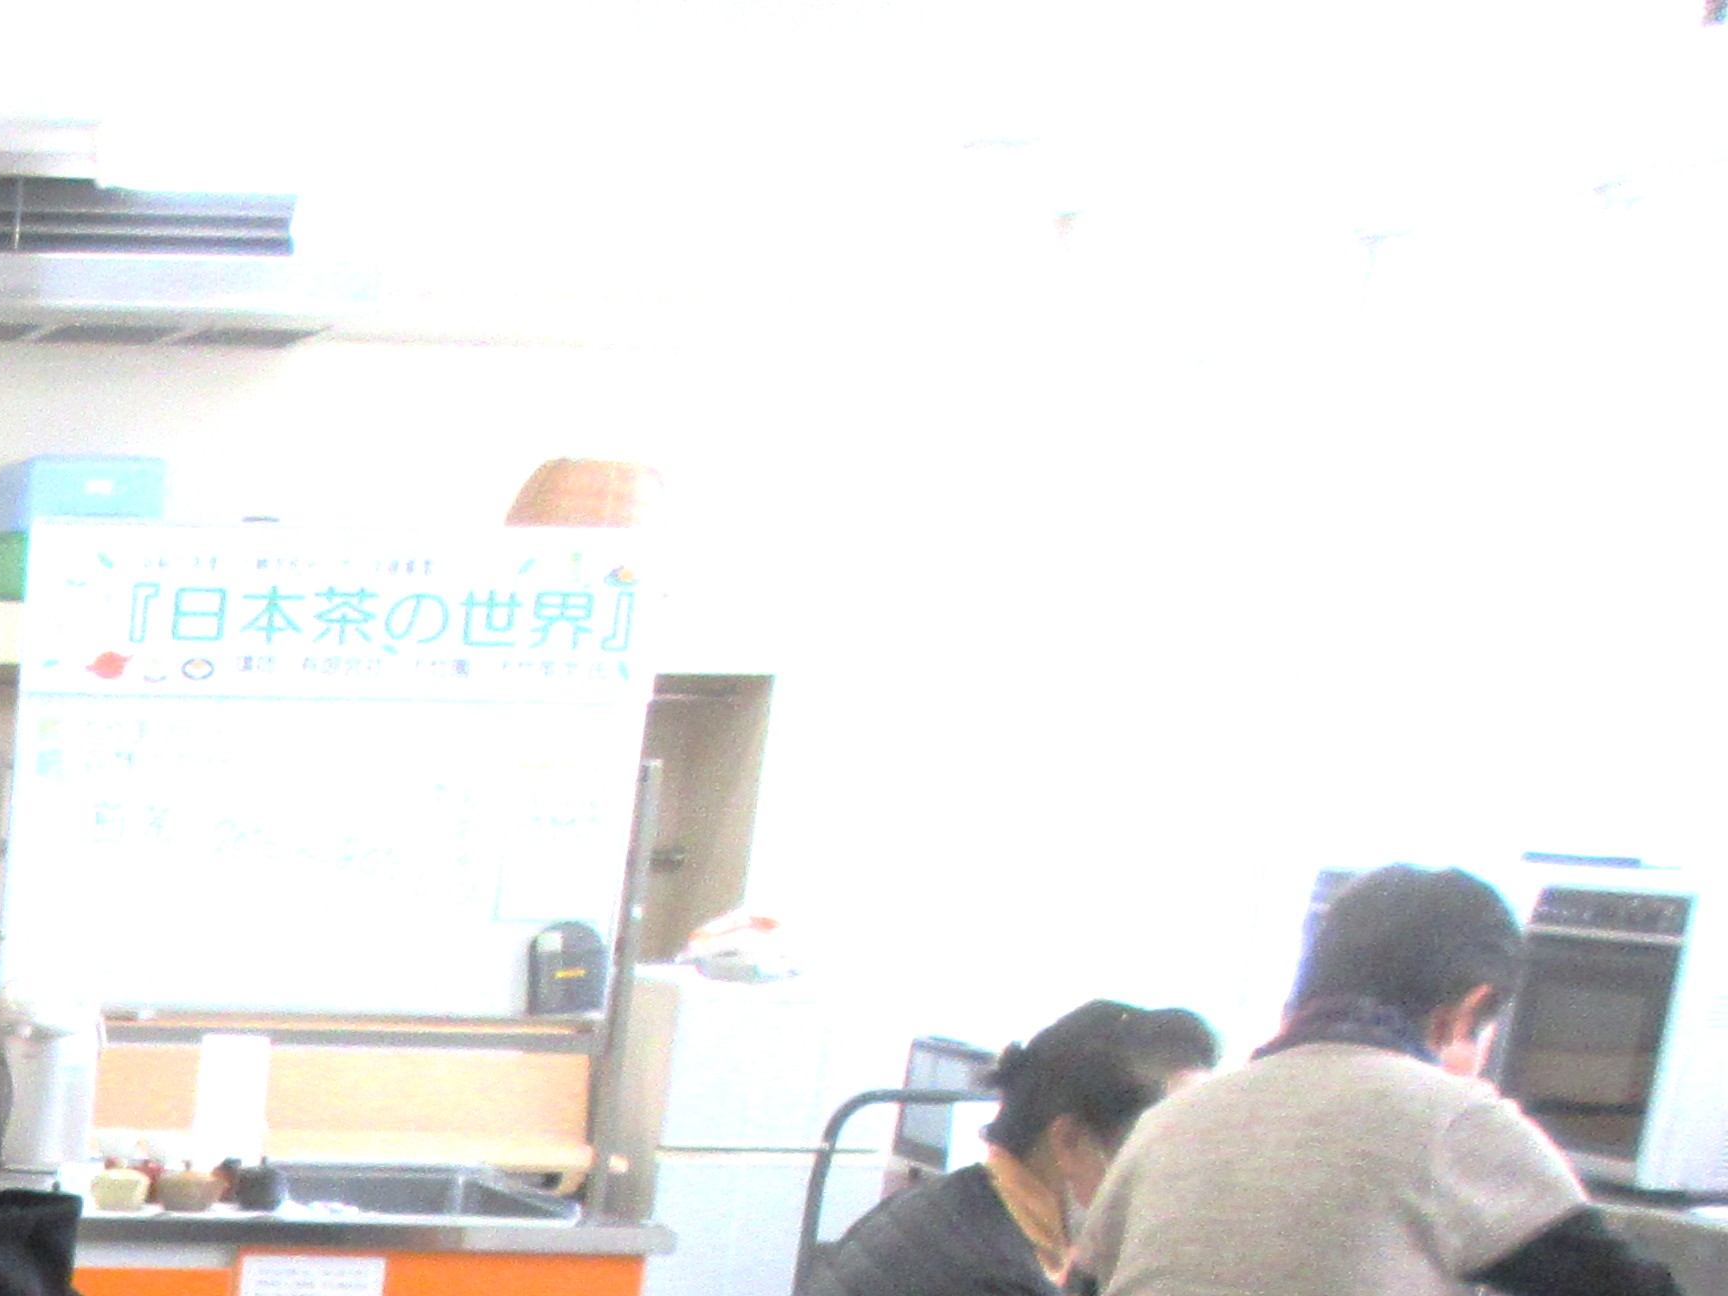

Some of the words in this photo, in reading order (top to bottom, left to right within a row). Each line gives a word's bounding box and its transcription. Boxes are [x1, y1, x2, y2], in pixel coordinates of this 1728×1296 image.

[126, 580, 637, 652] 『日本茶の世界』
